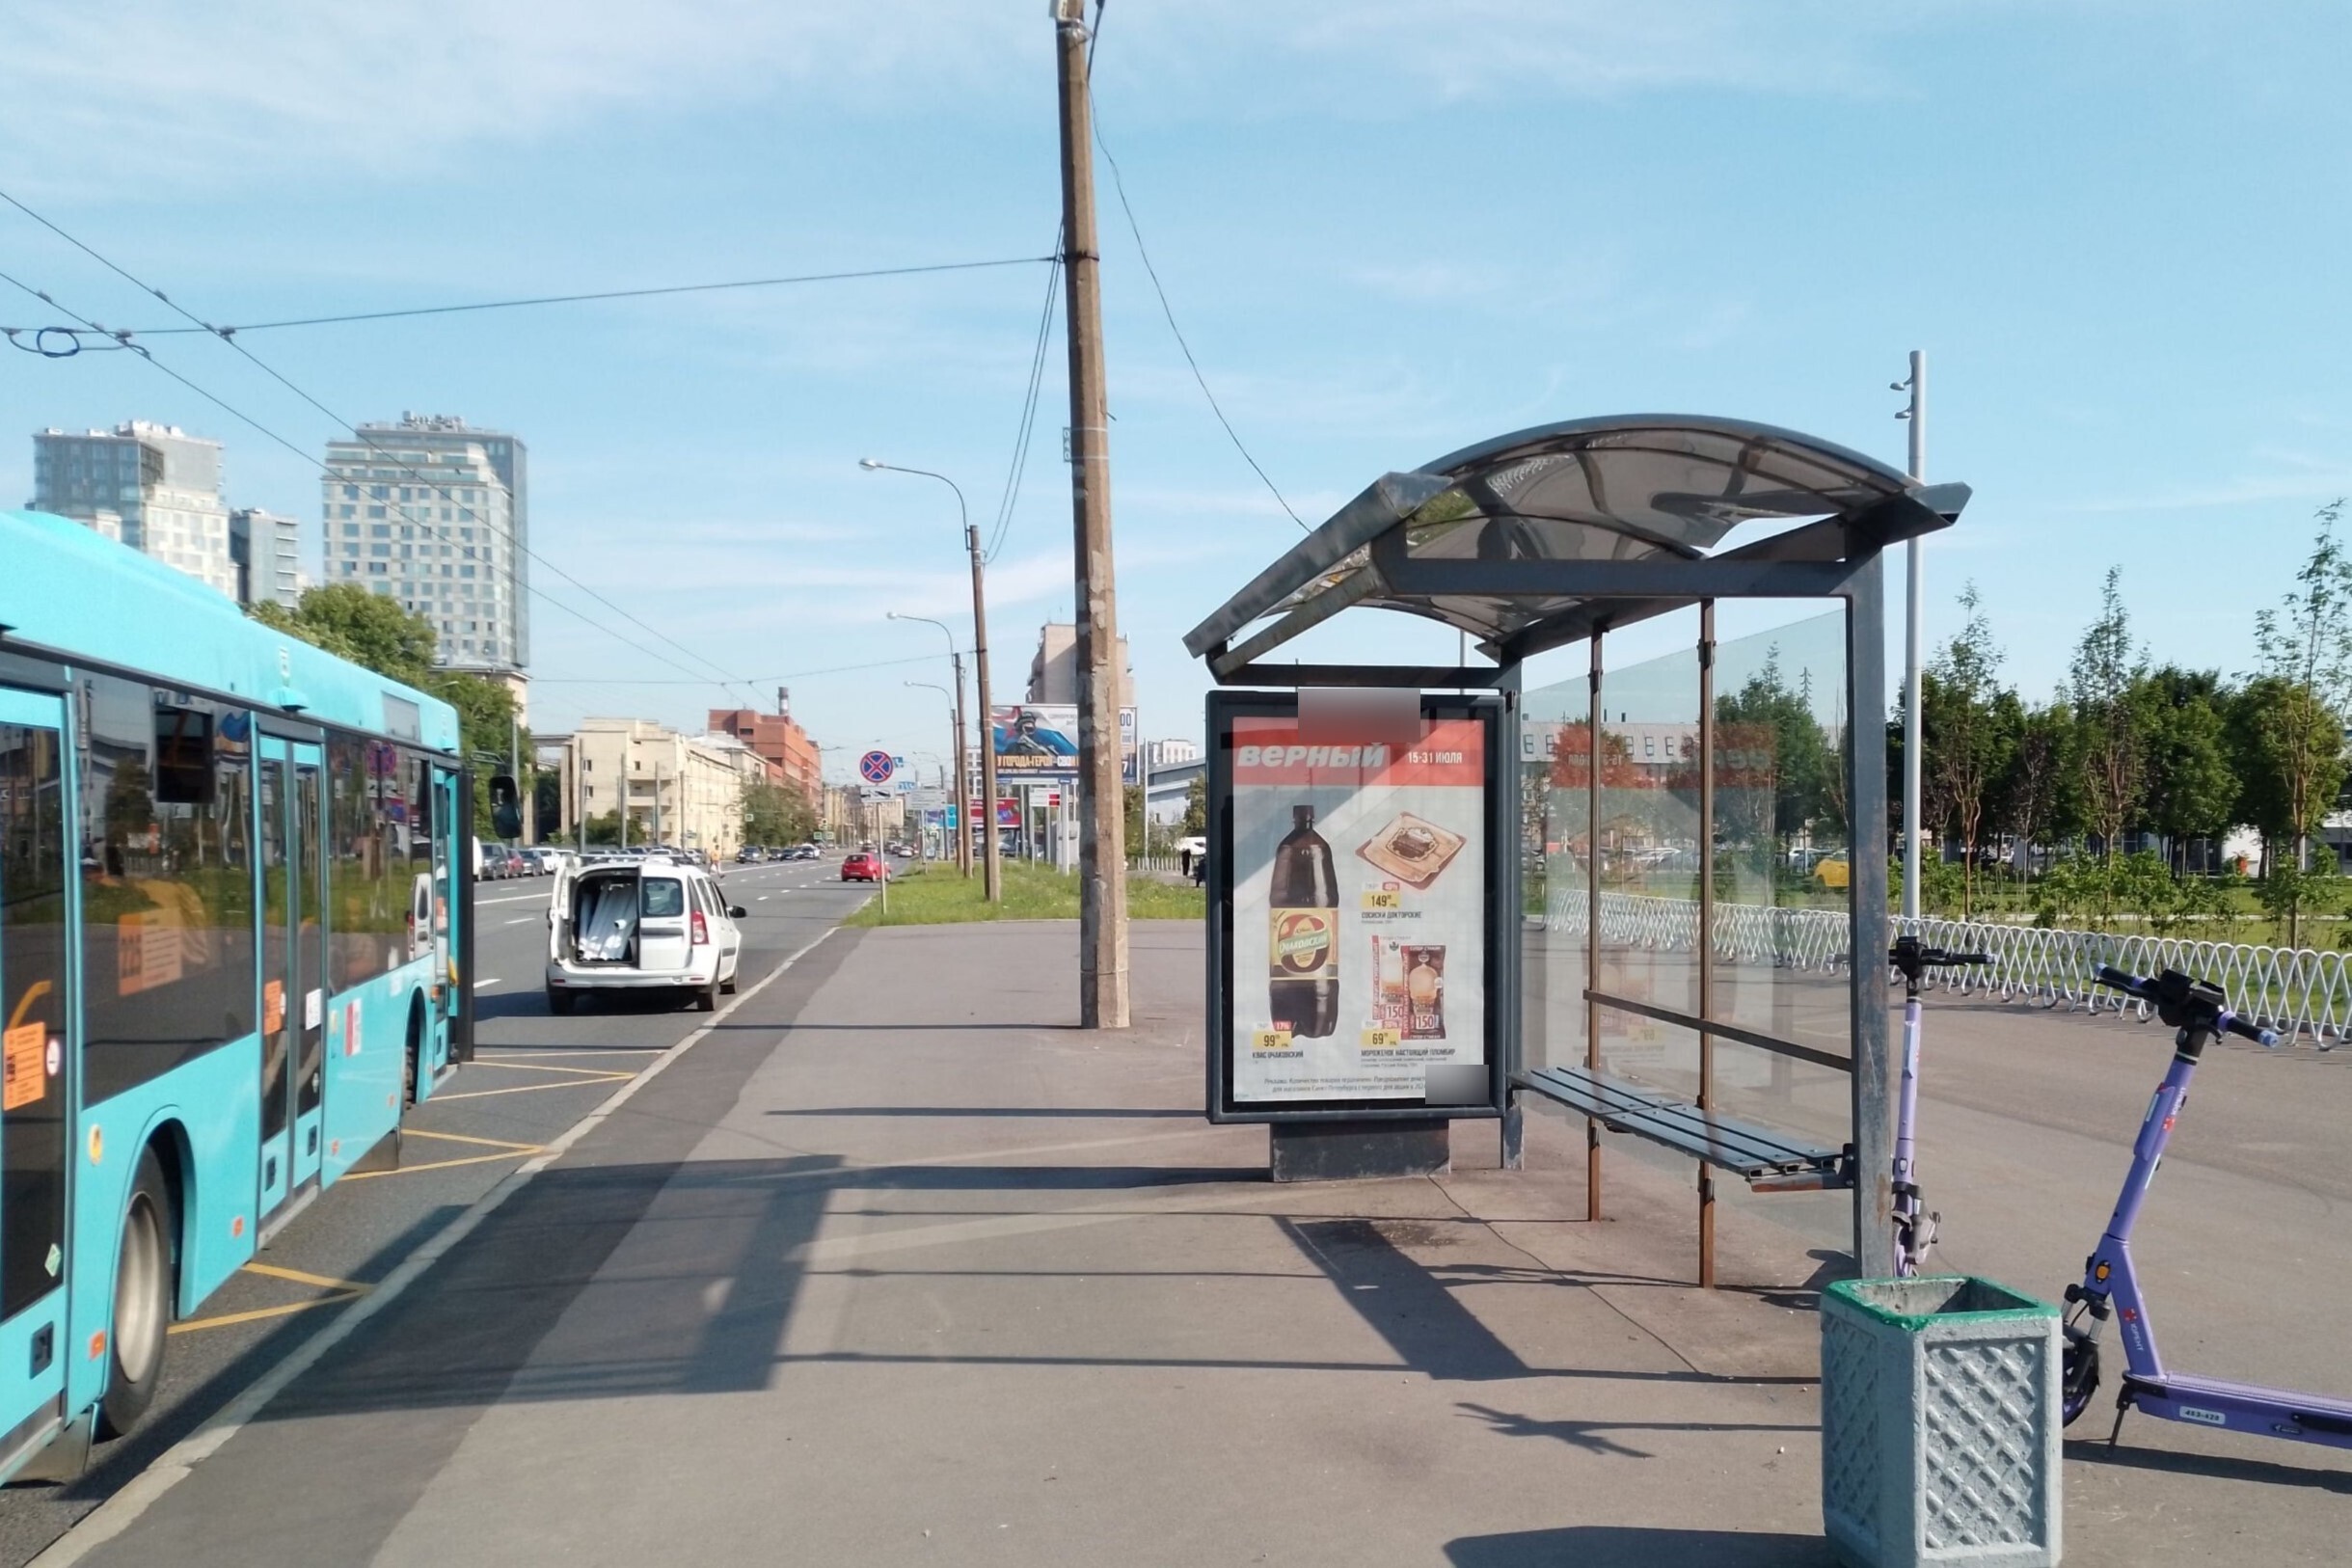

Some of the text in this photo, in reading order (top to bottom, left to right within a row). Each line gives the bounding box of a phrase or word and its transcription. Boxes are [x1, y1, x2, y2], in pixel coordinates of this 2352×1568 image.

[997, 755, 1003, 767] У
[1408, 751, 1463, 764] 15-31 ИЮЛЯ
[1371, 894, 1388, 907] 149
[1387, 1005, 1404, 1018] 150
[1416, 1014, 1434, 1028] 150
[1263, 1034, 1276, 1047] 99
[1372, 1033, 1384, 1045] 69
